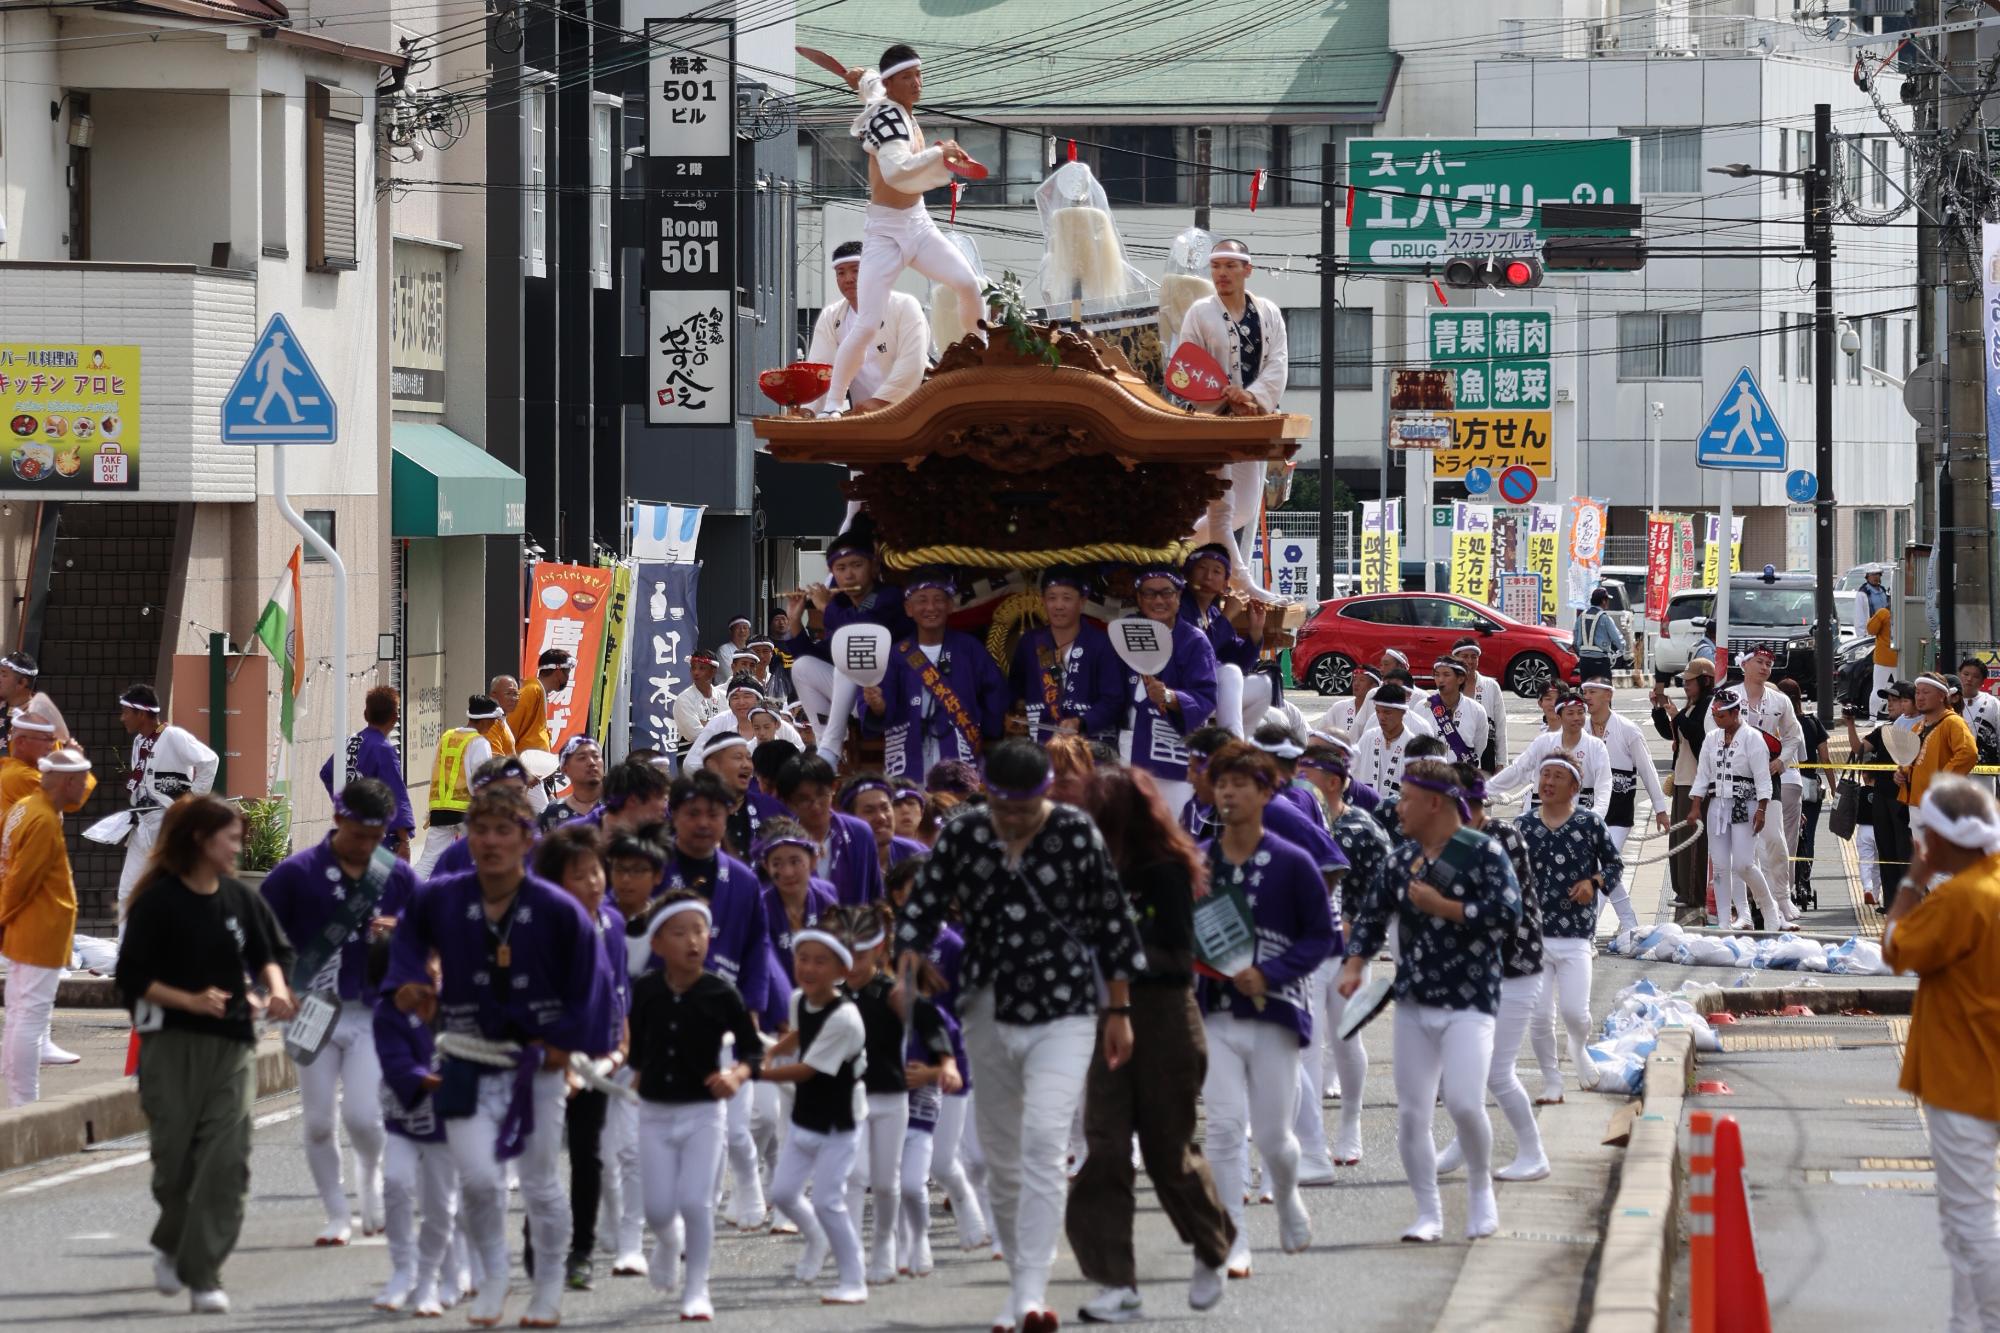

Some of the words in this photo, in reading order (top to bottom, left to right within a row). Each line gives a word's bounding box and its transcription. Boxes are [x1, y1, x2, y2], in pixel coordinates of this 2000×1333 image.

[669, 56, 708, 75] 橋本
[663, 81, 717, 102] 501
[671, 107, 707, 124] ビル
[676, 163, 702, 176] 2階
[1368, 150, 1466, 176] スーパー
[662, 217, 719, 238] Room
[1390, 243, 1438, 259] DRUG
[1449, 232, 1534, 250] スクランブル式
[661, 240, 719, 274] 501
[1434, 318, 1486, 354] 青果
[1495, 318, 1547, 354] 精肉
[74, 375, 126, 396] アロヒ
[1453, 368, 1486, 403] 魚
[1494, 368, 1547, 403] 惣菜
[100, 456, 121, 465] TAKE
[102, 465, 120, 473] OUT
[103, 474, 118, 482] OK!
[1278, 566, 1293, 595] 大吉
[1294, 566, 1308, 596] 買取
